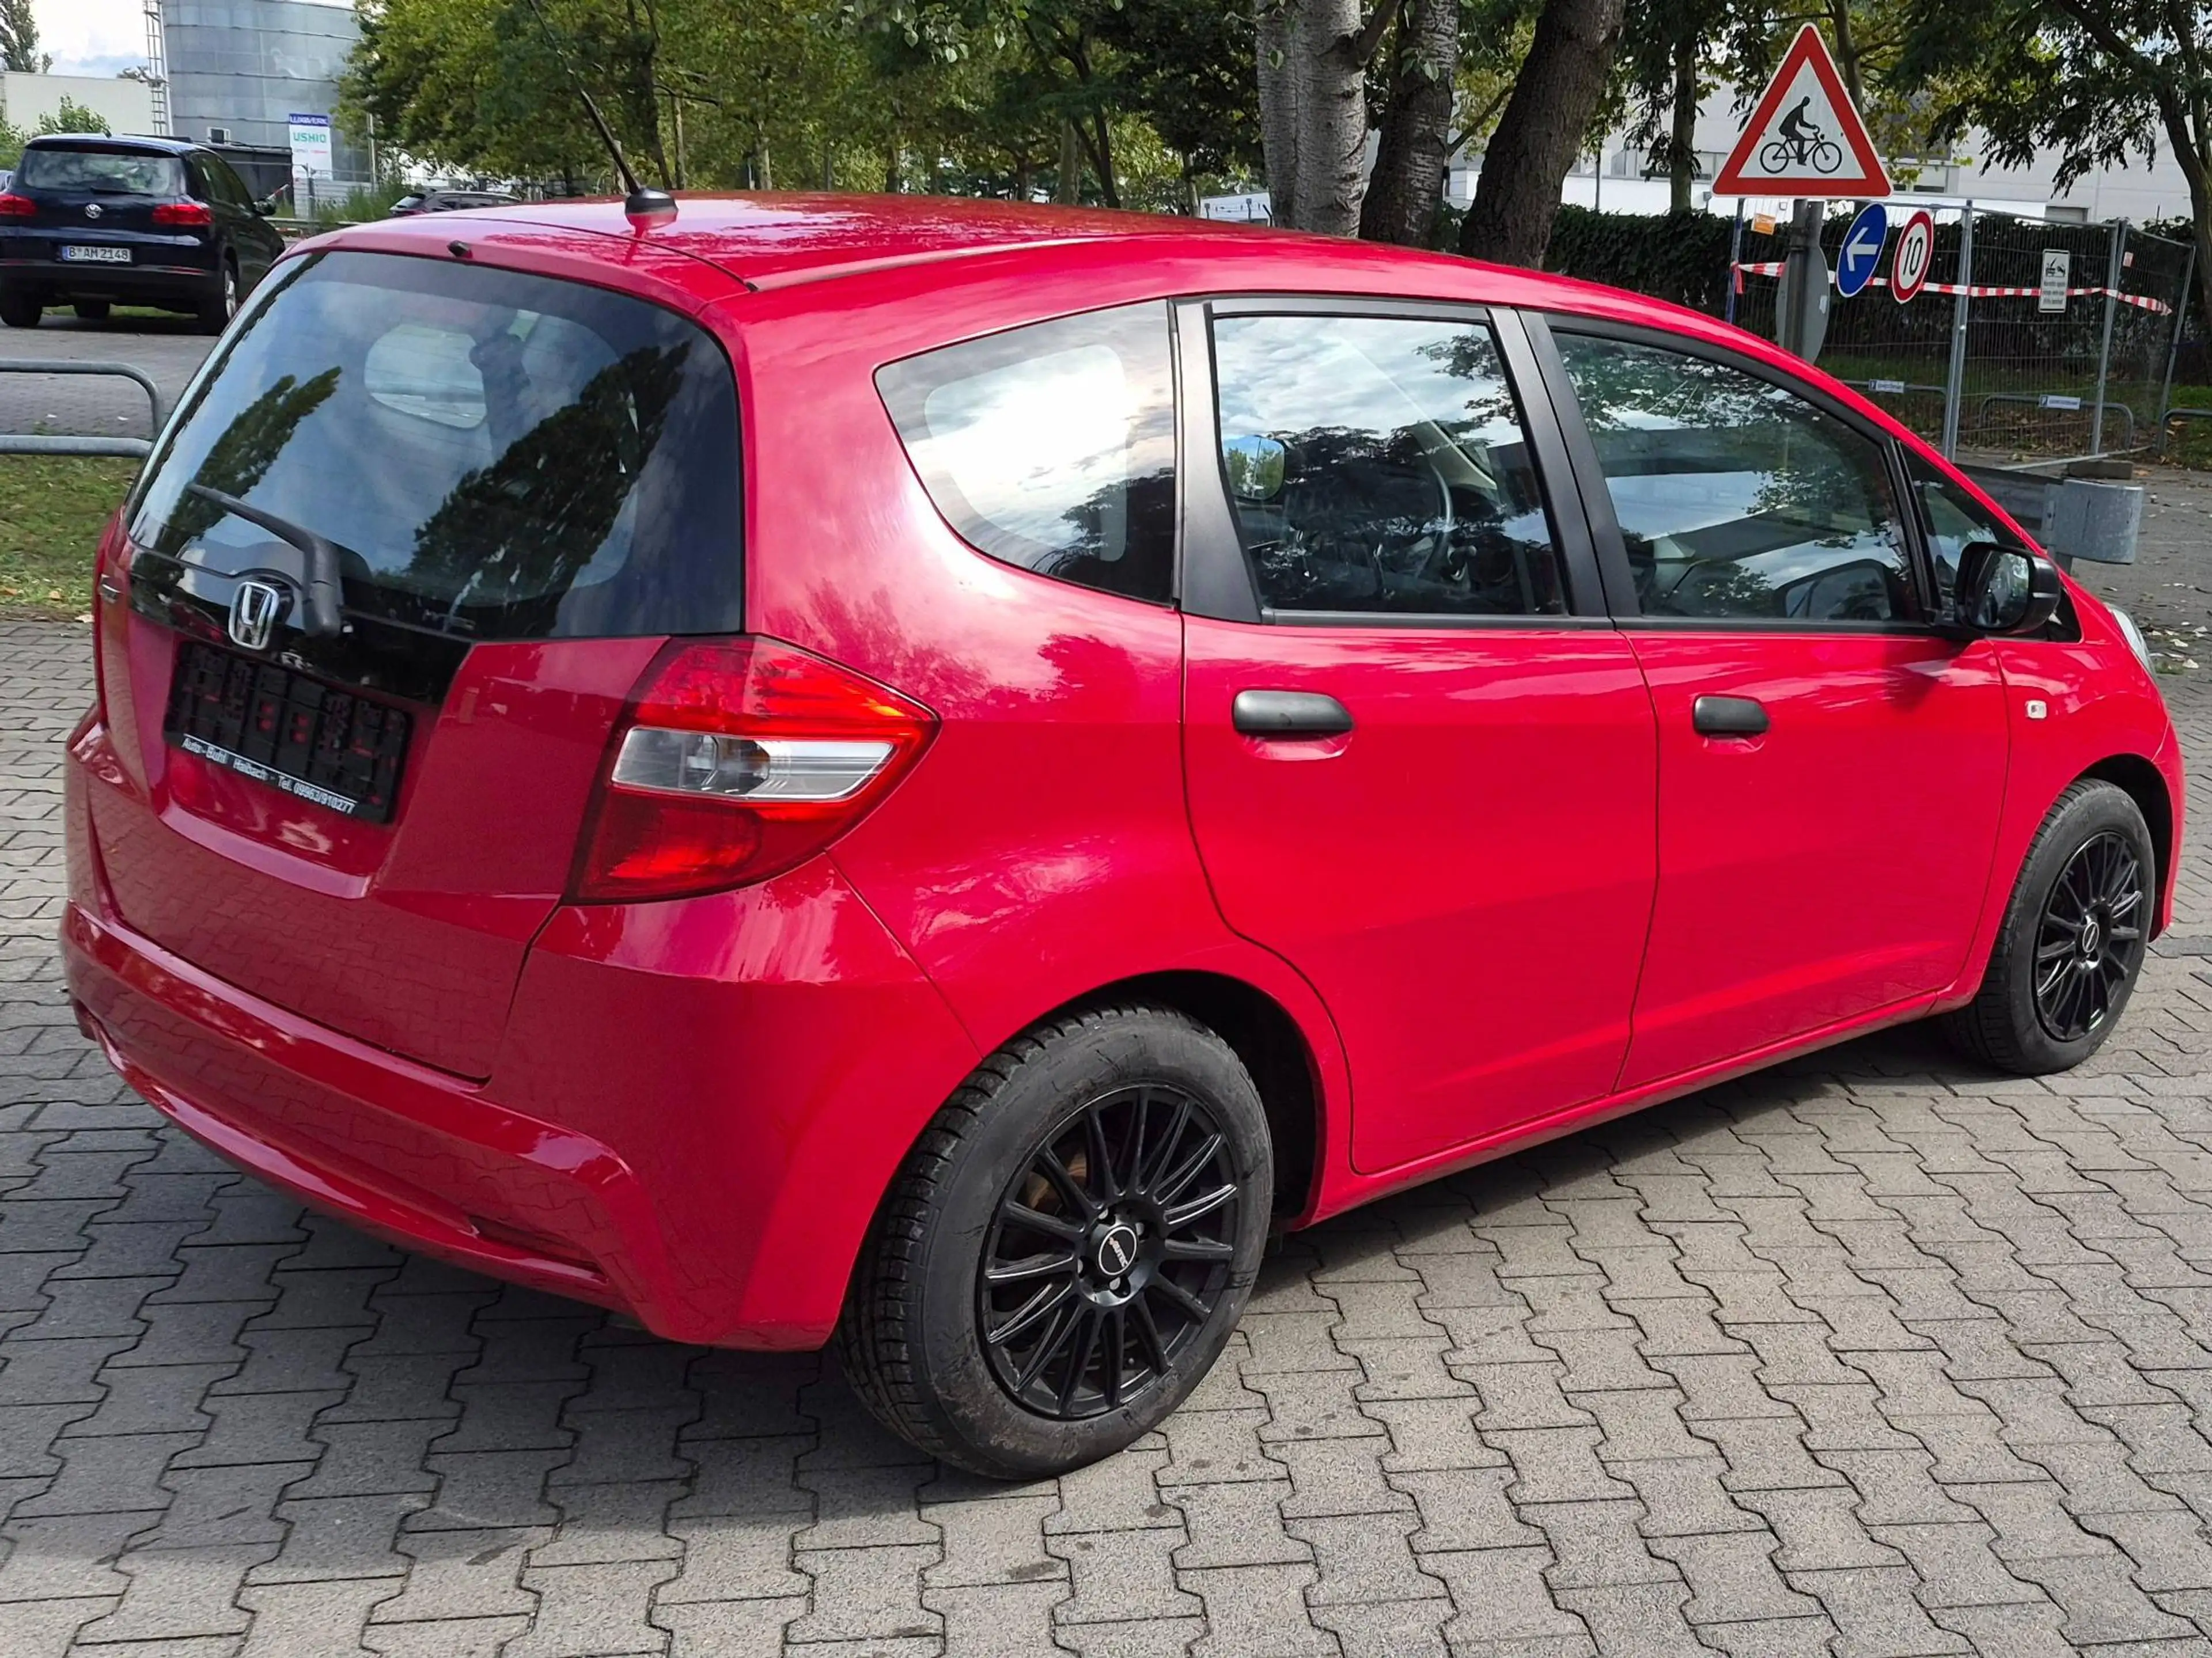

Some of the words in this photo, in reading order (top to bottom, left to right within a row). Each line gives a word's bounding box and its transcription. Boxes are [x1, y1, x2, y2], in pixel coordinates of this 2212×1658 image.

[293, 132, 327, 143] USHIO
[69, 247, 76, 257] B
[84, 248, 98, 258] AM
[1903, 236, 1923, 276] 10
